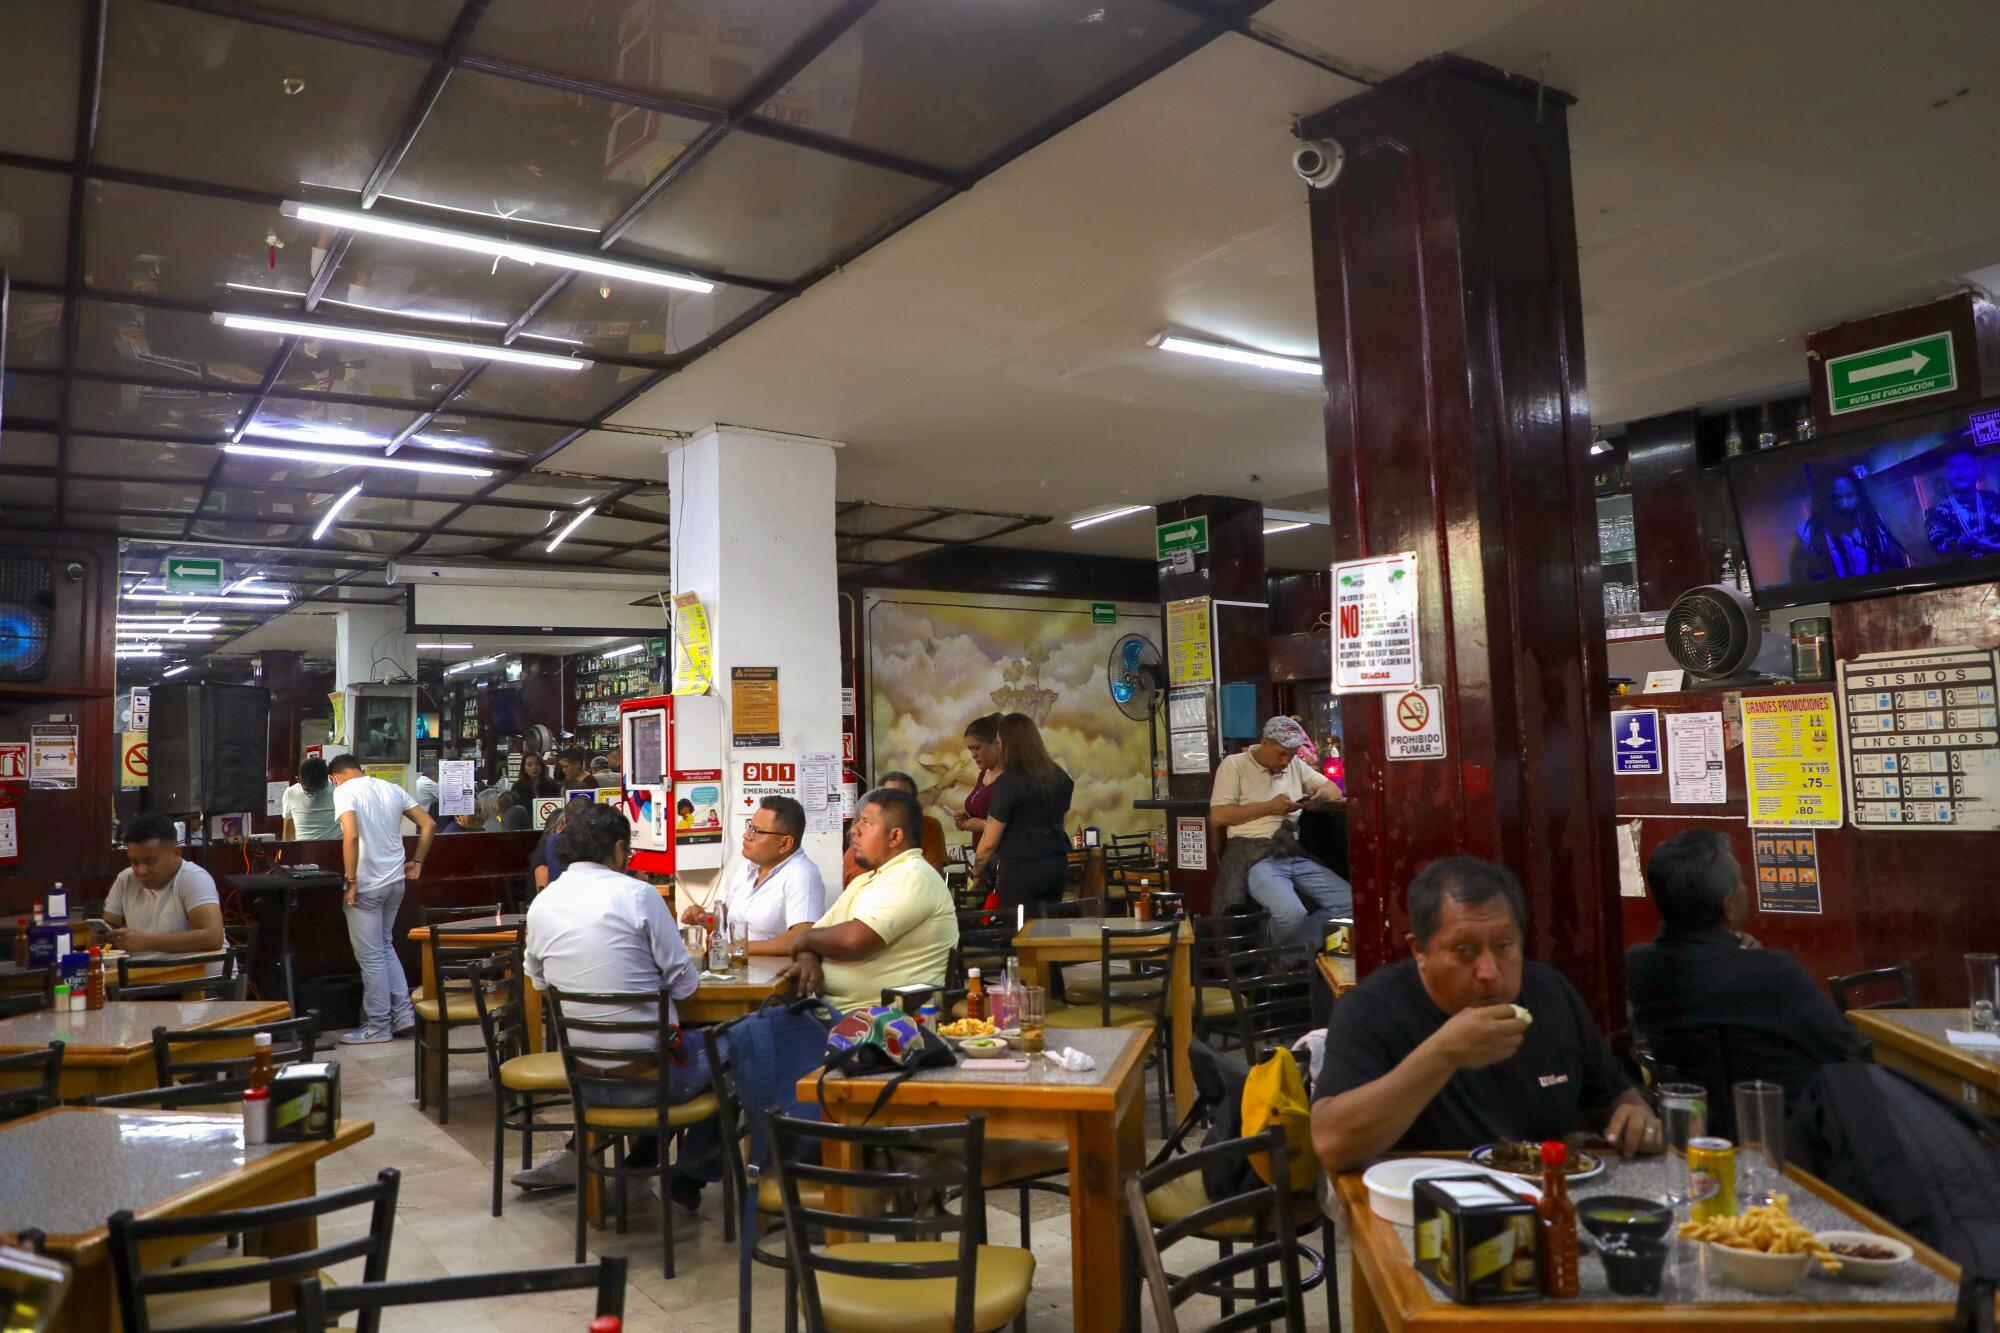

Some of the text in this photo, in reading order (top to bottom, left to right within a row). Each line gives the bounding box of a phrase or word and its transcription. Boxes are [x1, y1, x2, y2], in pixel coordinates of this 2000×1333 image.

[1849, 394, 1869, 405] RUTA
[1340, 604, 1359, 639] NO
[1903, 658, 1933, 666] HACER
[1865, 669, 1966, 687] SISMOS
[1746, 697, 1829, 714] GRANDES PROMOCIONES
[1849, 696, 1855, 712] 1
[1896, 693, 1904, 709] 2
[1946, 690, 1955, 706] 3
[1850, 716, 1858, 733] 4
[1897, 714, 1905, 730] 5
[1948, 711, 1956, 727] 6
[1391, 734, 1440, 745] PROHIBIDO
[1863, 733, 1984, 747] INCENDIOS
[1400, 744, 1432, 754] FUMAR
[1855, 758, 1860, 772] 1
[1902, 755, 1909, 771] 2
[1951, 754, 1960, 770] 3
[746, 764, 792, 780] 911
[743, 787, 796, 795] EMERGENCIAS
[1856, 780, 1863, 795] 4
[1904, 780, 1912, 796] 5
[1954, 779, 1962, 794] 6
[1538, 1074, 1569, 1088] Wilson
